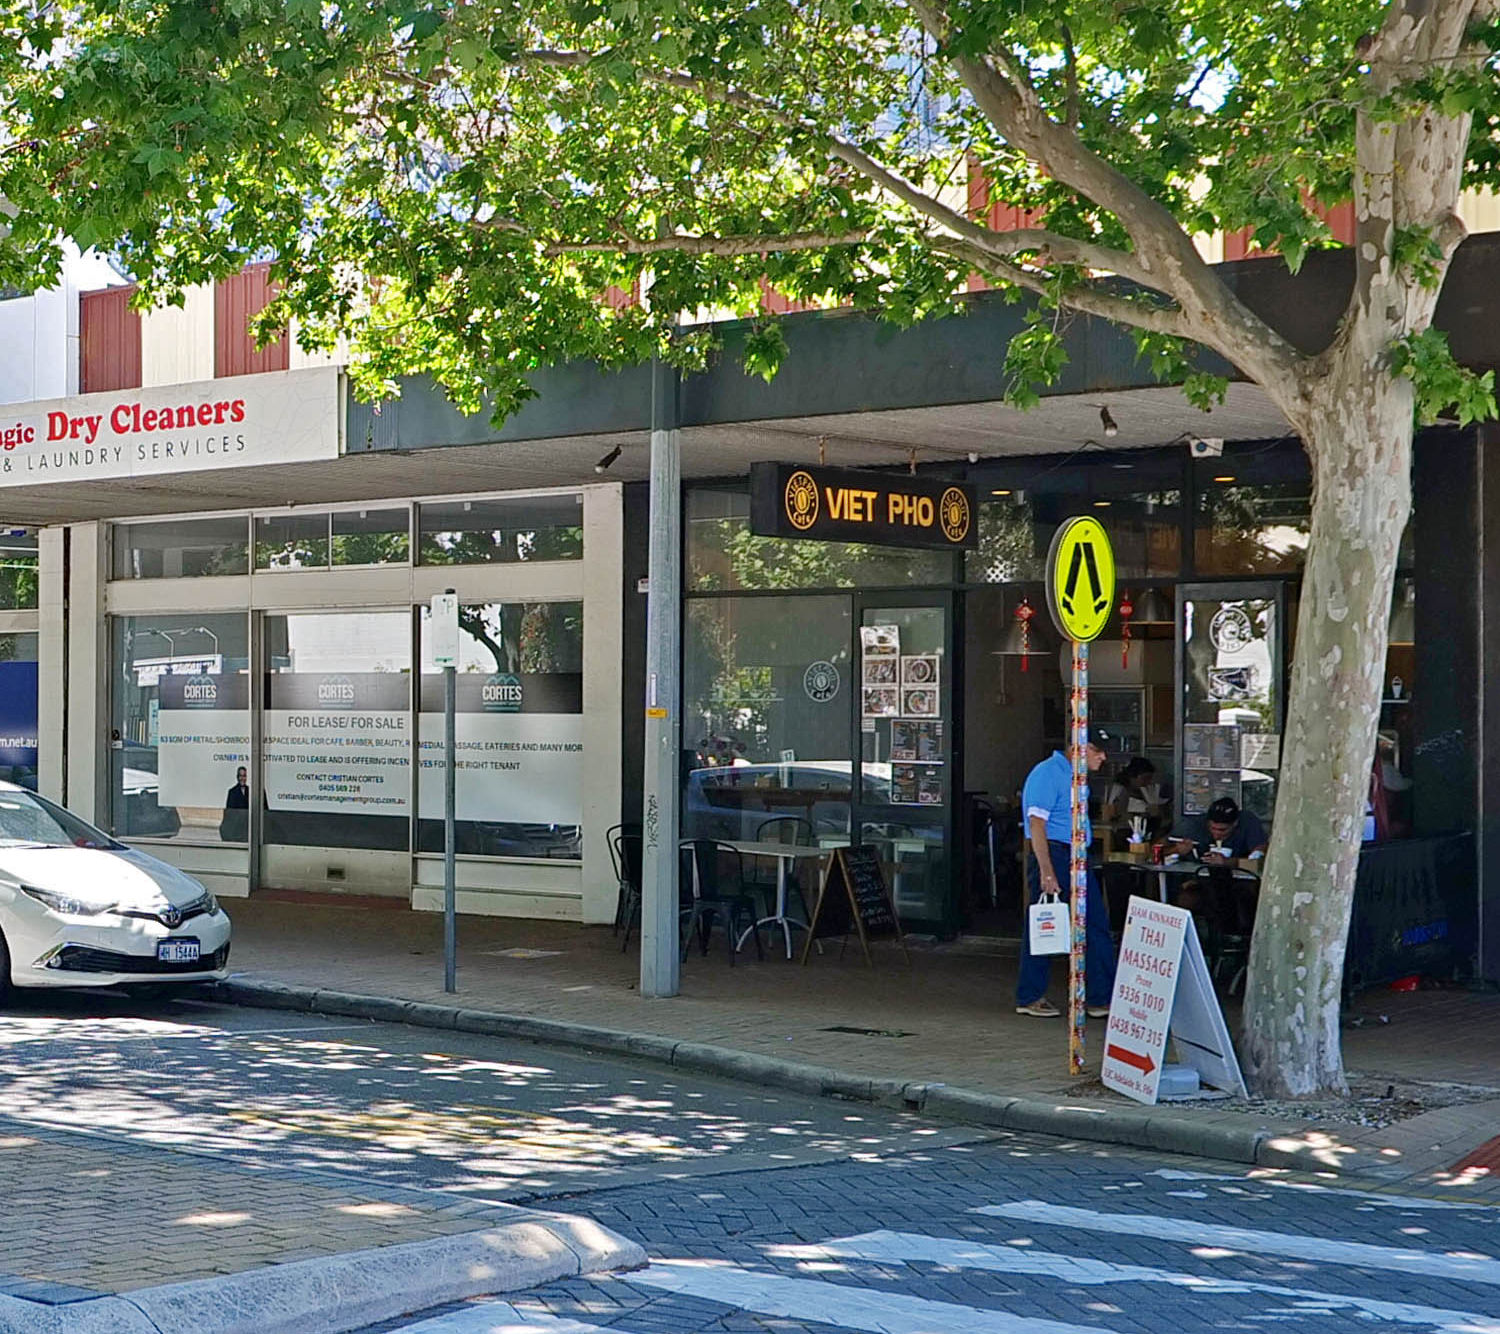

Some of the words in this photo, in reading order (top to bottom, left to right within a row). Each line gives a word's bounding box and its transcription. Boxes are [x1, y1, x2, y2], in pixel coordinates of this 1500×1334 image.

[48, 411, 103, 444] Dry
[111, 399, 245, 435] Cleaners
[3, 458, 12, 472] &
[28, 447, 121, 470] LAUNDRY
[138, 435, 245, 460] SERVICES
[825, 487, 878, 523] VIET
[888, 492, 934, 528] PHO
[184, 685, 217, 698] CORTES
[318, 684, 354, 699] CORTES
[482, 685, 522, 701] CORTES
[288, 716, 310, 728] FOR
[351, 717, 373, 729] FOR
[375, 717, 404, 729] SALE
[485, 742, 520, 751] EATERIES
[521, 743, 538, 751] AND
[540, 743, 563, 752] MANY
[307, 755, 326, 763] LEASE
[328, 756, 344, 764] AND
[352, 756, 386, 765] OFFERING
[466, 761, 488, 769] RIGHT
[490, 761, 520, 770] TENANT
[296, 773, 326, 781] CONTACT
[1140, 926, 1166, 948] THAI
[1122, 948, 1174, 979] MASSAGE
[1135, 974, 1152, 989] Phone
[1119, 984, 1140, 1003] 9336
[1142, 992, 1165, 1012] 1010
[1129, 1006, 1148, 1021] Mobile
[1110, 1015, 1130, 1035] 0438
[1130, 1025, 1146, 1041] 967
[1147, 1031, 1163, 1047] 315
